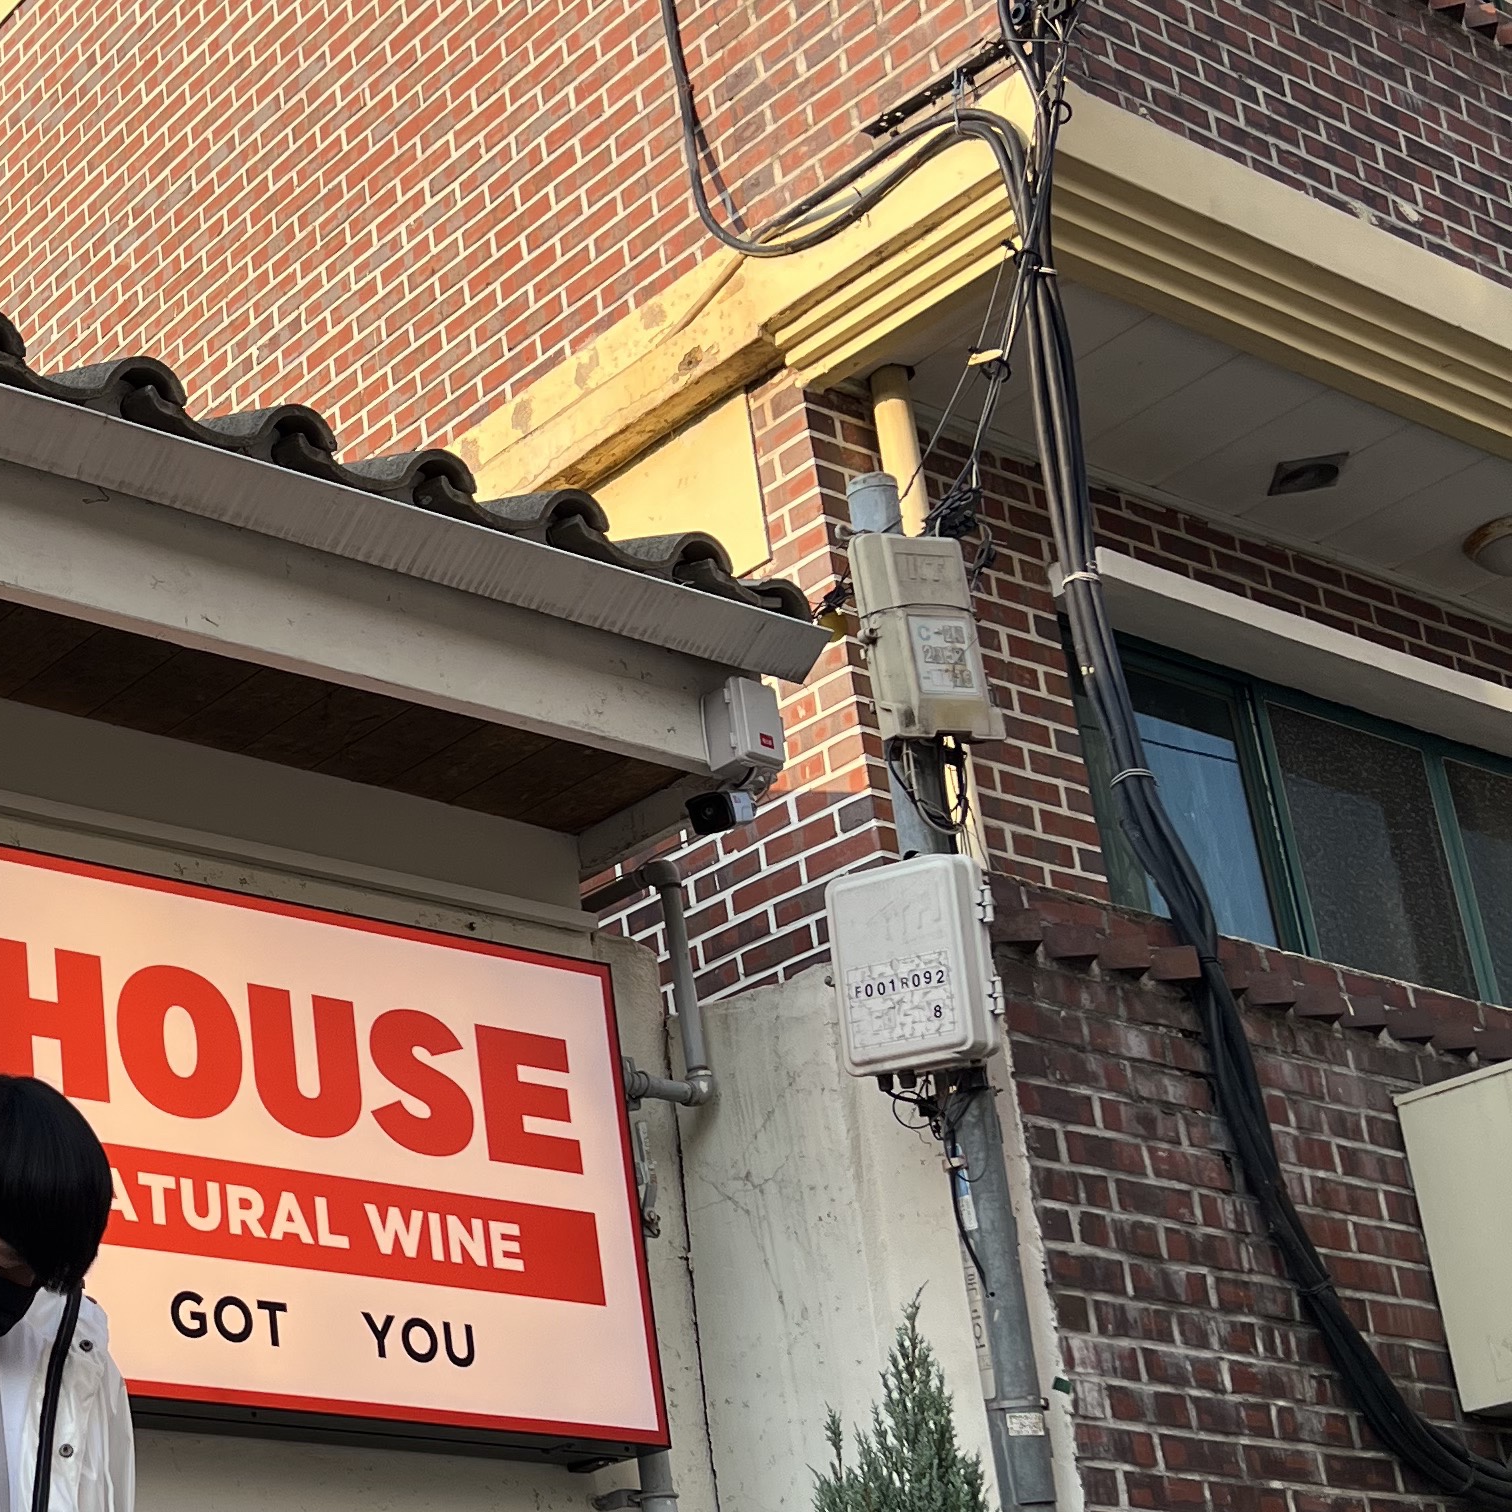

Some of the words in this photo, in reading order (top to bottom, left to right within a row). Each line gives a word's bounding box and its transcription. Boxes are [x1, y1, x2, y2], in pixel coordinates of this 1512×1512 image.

[933, 1004, 943, 1019] 8
[109, 1167, 350, 1249] ATURAL
[363, 1203, 525, 1272] WINE
[170, 1290, 288, 1347] GOT
[361, 1311, 475, 1368] YOU
